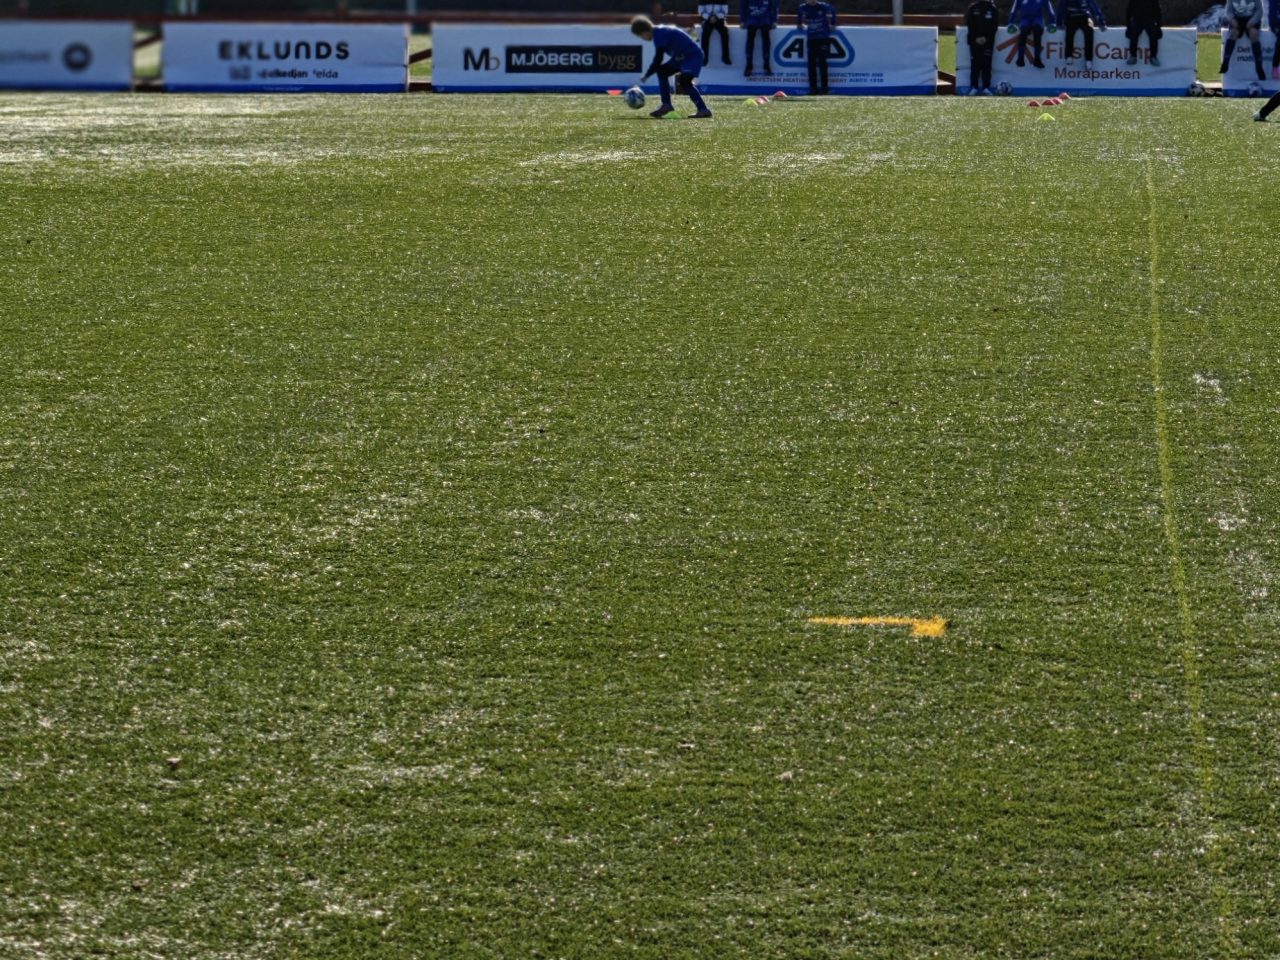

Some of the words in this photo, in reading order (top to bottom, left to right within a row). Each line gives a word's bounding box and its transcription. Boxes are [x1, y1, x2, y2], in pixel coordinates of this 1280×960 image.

[218, 41, 350, 60] EKLUNDS
[1046, 42, 1089, 60] Fis
[511, 50, 594, 66] MJÖBERG
[598, 52, 636, 70] bygg
[1054, 67, 1141, 82] Moraparken
